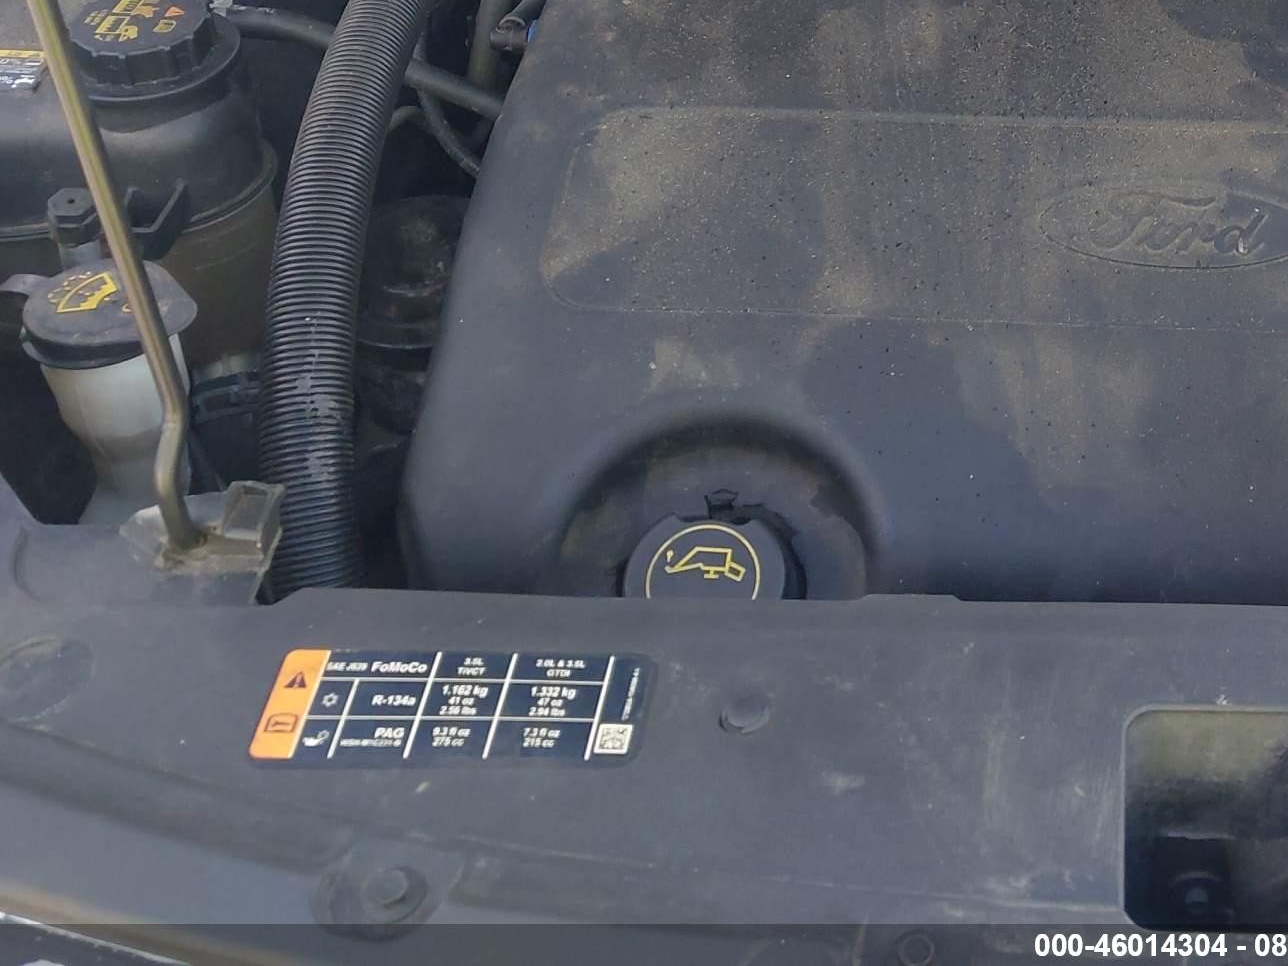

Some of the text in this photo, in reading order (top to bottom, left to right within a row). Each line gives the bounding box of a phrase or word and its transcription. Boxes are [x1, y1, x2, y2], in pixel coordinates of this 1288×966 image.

[1091, 187, 1267, 255] Ford
[371, 661, 428, 673] FoMoCo
[473, 685, 489, 699] kg
[530, 686, 577, 700] 1.332 kg
[371, 694, 417, 706] R-134a
[537, 697, 550, 706] 47
[374, 727, 405, 738] PAG
